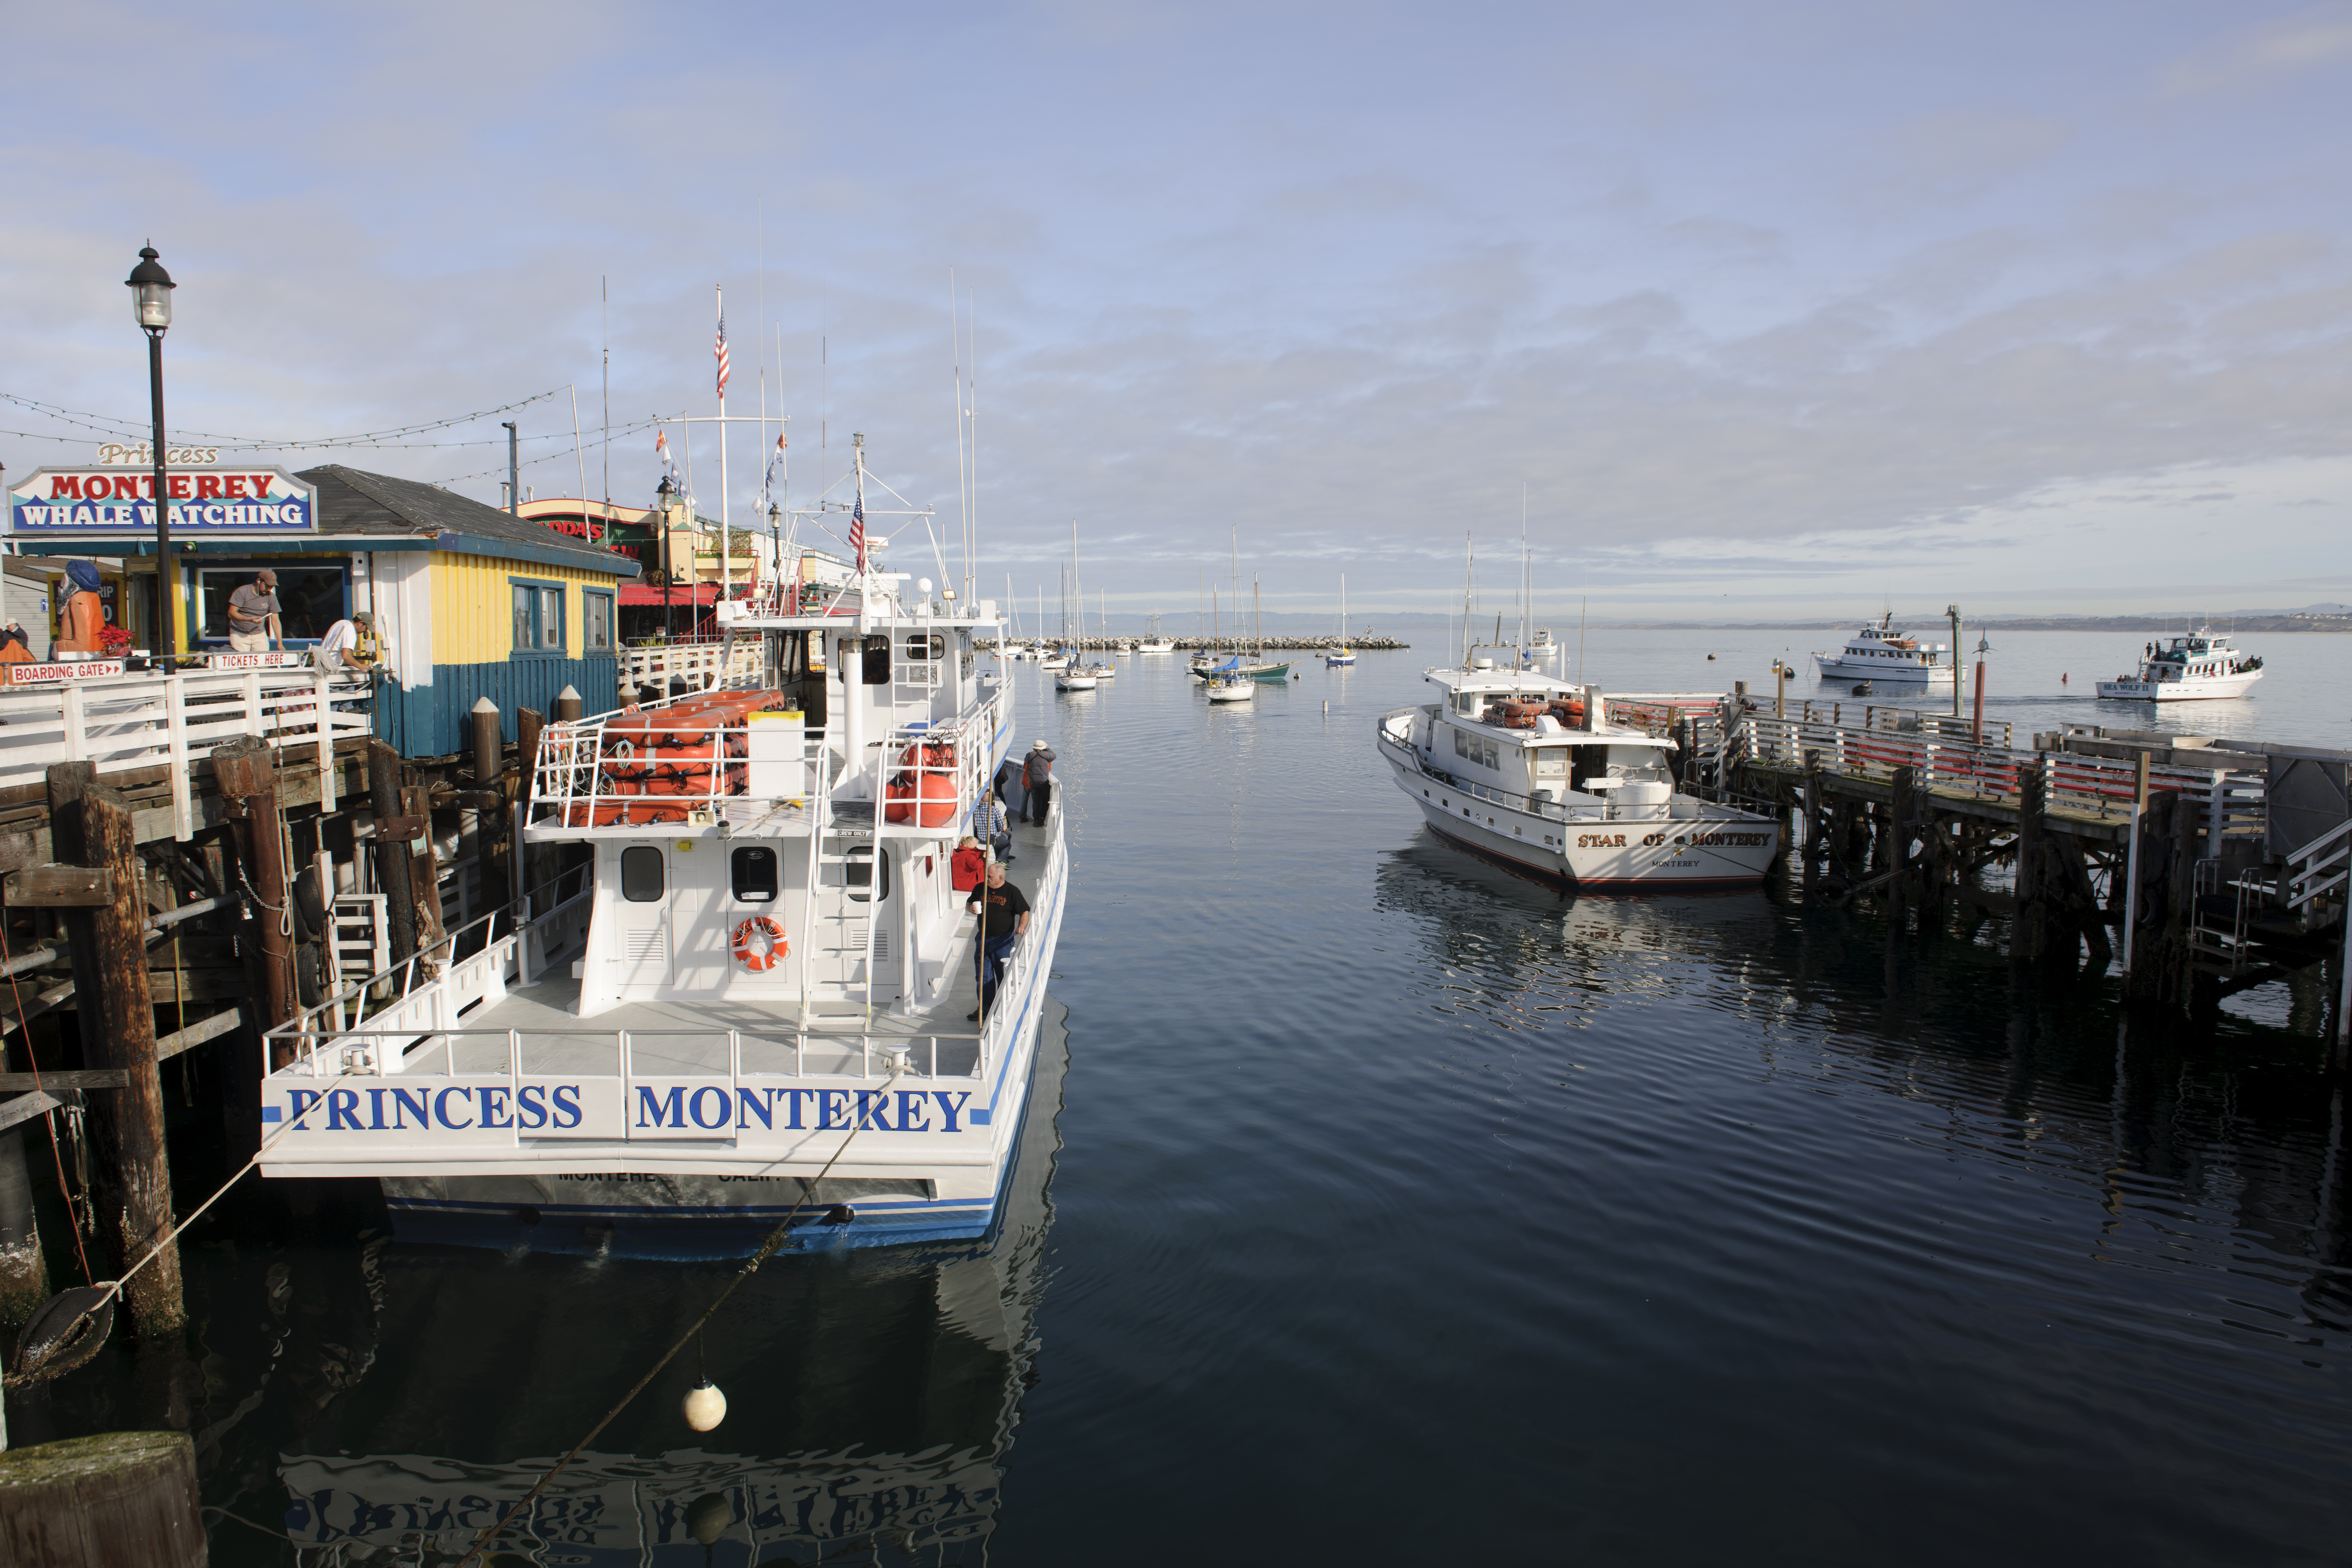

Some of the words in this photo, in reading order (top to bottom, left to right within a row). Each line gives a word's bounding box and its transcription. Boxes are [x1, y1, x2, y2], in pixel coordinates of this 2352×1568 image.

[51, 476, 273, 499] MONTEREY
[22, 506, 133, 525] WHALE
[138, 505, 303, 525] WATCHING
[97, 586, 114, 598] RIP
[222, 655, 258, 667] TICKETS
[265, 654, 284, 665] HERE
[15, 666, 74, 681] BOARDING
[79, 664, 104, 676] GATE
[1578, 834, 1627, 847] STAR
[1643, 833, 1666, 846] OF
[1691, 833, 1773, 846] MONTEREY
[980, 895, 1006, 906] GANTS
[286, 1085, 583, 1130] PRINCESS
[635, 1086, 972, 1132] MONTEREY
[559, 1172, 656, 1182] MONTERE
